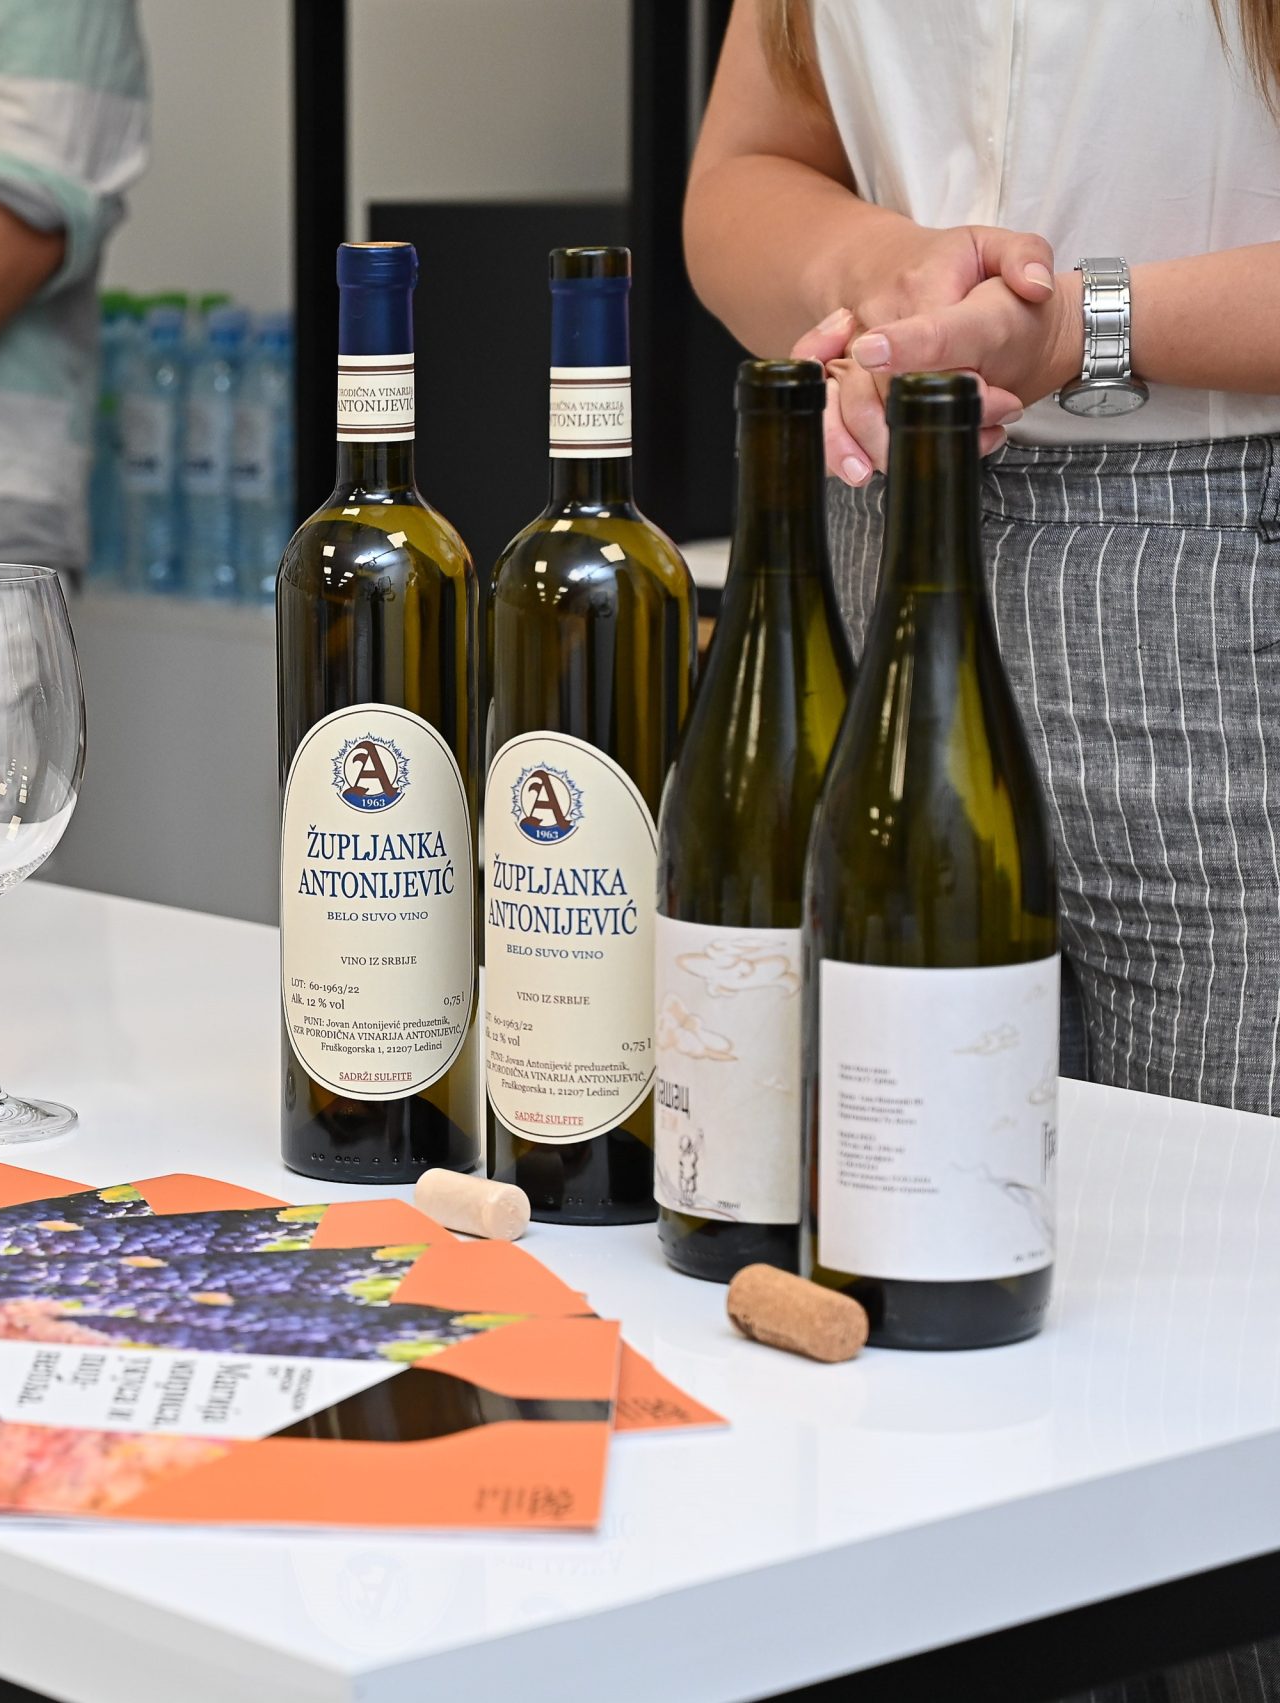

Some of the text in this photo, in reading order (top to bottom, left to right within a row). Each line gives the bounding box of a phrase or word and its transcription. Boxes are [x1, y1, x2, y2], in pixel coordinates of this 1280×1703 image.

[551, 409, 625, 427] TONIJEVIĆ
[342, 740, 399, 797] A
[362, 798, 385, 808] 1963
[520, 769, 573, 831] A
[307, 824, 447, 861] ŽUPLJANKA
[536, 829, 559, 840] 1963
[298, 860, 455, 899] ANTONIJEVIĆ
[493, 853, 628, 896] ŽUPLJANKA
[327, 911, 429, 922] BELO SUVO VINO
[488, 898, 638, 936] ANTONIJEVIĆ
[506, 943, 604, 960] BELO SUVO VINO
[340, 955, 417, 966] VINO IZ SRBIJE
[291, 977, 360, 995] LOT: 60-1963/22
[291, 993, 345, 1010] Alk. 12 % vol
[516, 991, 591, 1006] VINO IZ SRBIJE
[303, 1015, 450, 1031] PUNI: Jovan Antonijević preduzetnik,
[493, 1015, 533, 1032] 60-1963/22
[306, 1026, 356, 1040] PORODIČNA
[357, 1032, 404, 1041] VINARIJA
[508, 1035, 521, 1047] vol
[321, 1041, 442, 1055] Fruškogorska 1, 21207 Ledinci
[505, 1054, 525, 1067] Jovan
[526, 1059, 572, 1074] Antonijević
[574, 1061, 630, 1073] preduzetnik,
[339, 1072, 413, 1082] SADRŽI SULFITE
[531, 1070, 575, 1084] VINARIJA
[501, 1079, 547, 1095] Fruškogorska
[558, 1088, 585, 1098] 21207
[586, 1087, 620, 1097] Ledinci
[515, 1110, 584, 1126] SADRŽI SULFITE
